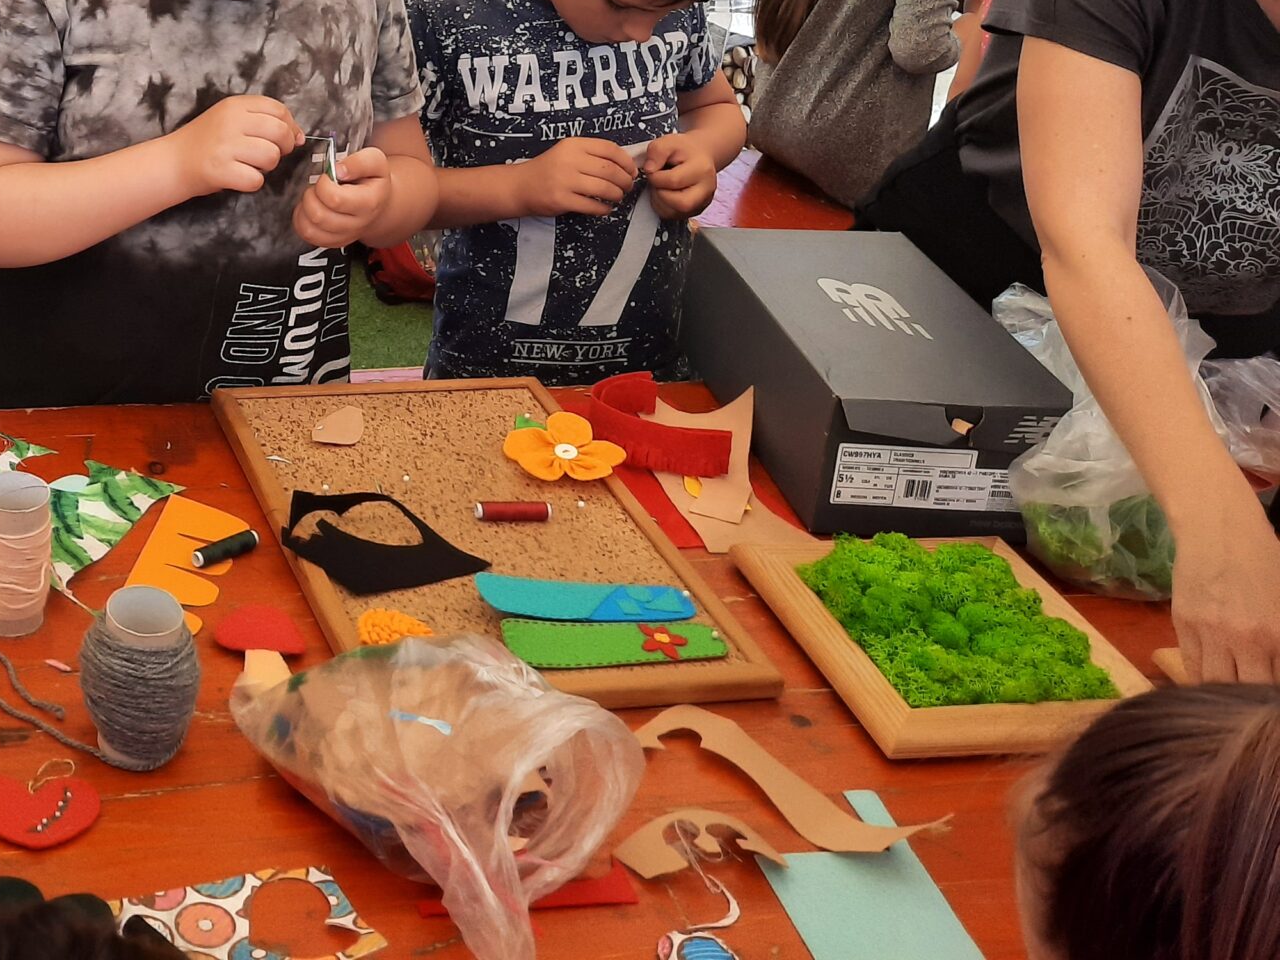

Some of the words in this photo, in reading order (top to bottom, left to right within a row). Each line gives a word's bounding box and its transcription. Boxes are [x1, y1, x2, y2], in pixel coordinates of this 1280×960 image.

[541, 119, 586, 141] NEW
[593, 112, 634, 134] YORK
[220, 283, 289, 364] AND
[512, 342, 564, 360] NEW
[575, 342, 631, 359] YORK
